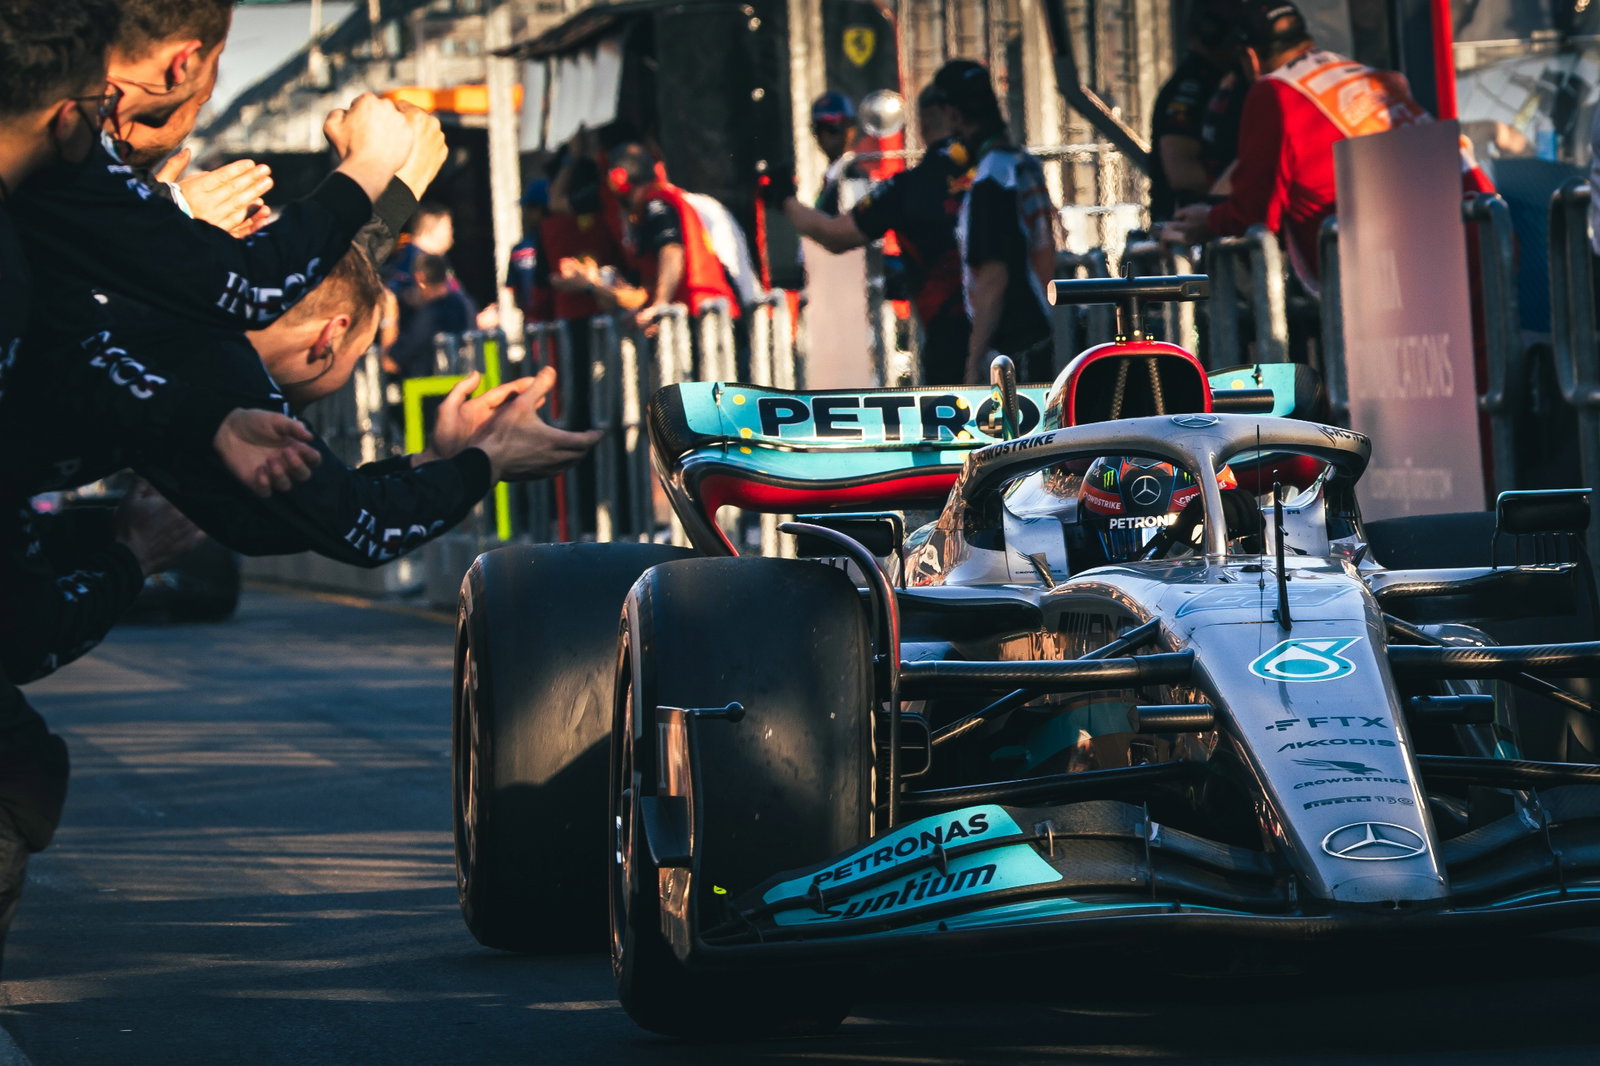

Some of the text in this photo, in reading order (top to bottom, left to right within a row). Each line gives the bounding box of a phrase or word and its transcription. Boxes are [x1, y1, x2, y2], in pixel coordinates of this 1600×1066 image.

[757, 395, 1050, 442] PETRO
[1307, 716, 1389, 729] FTX
[1277, 738, 1397, 753] AKKODIS
[1293, 776, 1409, 790] CROWDSTRIKE
[1303, 795, 1372, 811] PIRELLI
[812, 812, 990, 886] PETRONAS
[807, 862, 998, 921] Syntium
